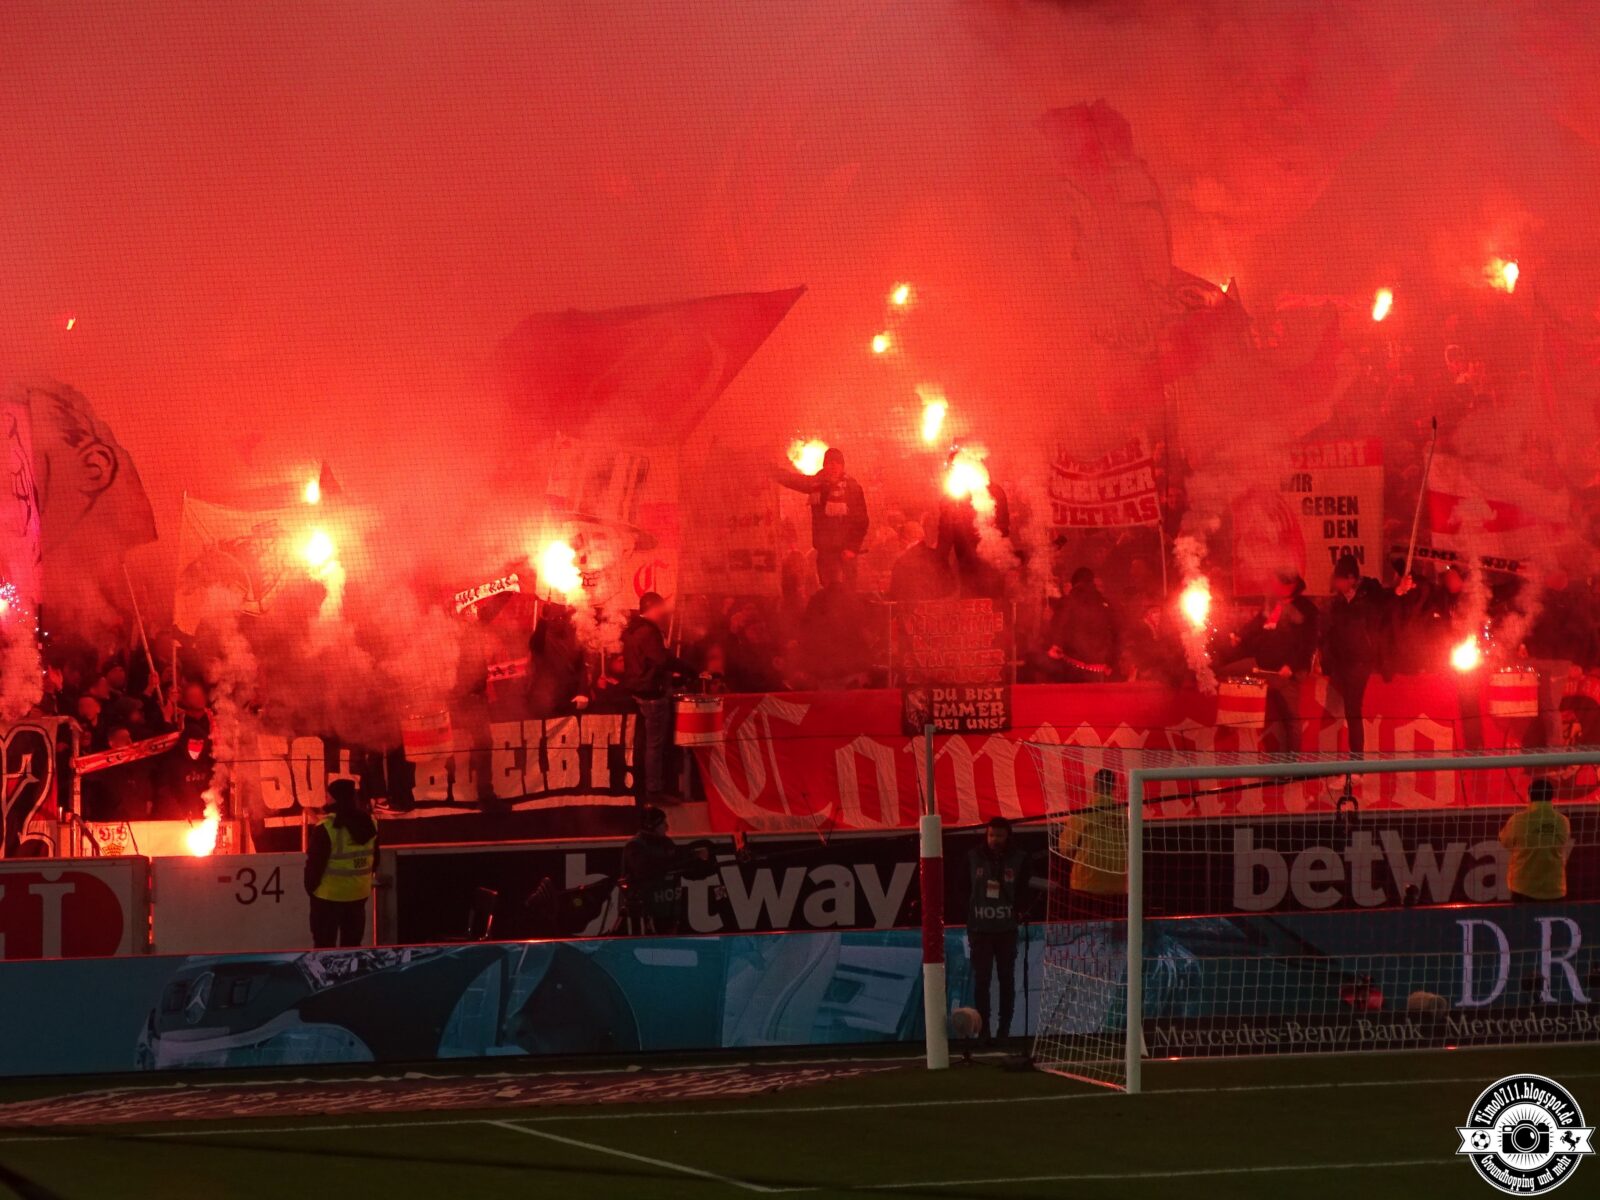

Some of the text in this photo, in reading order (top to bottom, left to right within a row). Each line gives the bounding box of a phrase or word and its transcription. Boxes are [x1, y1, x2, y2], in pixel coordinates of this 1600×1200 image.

[1052, 496, 1160, 525] ULTRAS
[1301, 496, 1359, 516] GEBEN
[1323, 519, 1359, 539] DEN
[932, 687, 1004, 700] DU BIST
[933, 702, 1004, 717] IMMER
[933, 717, 1006, 730] BEI UNS!
[1233, 828, 1575, 911] betwa
[974, 905, 1013, 919] HOST
[1154, 1021, 1350, 1048] Mercedes-Benz
[1358, 1017, 1424, 1042] Bank
